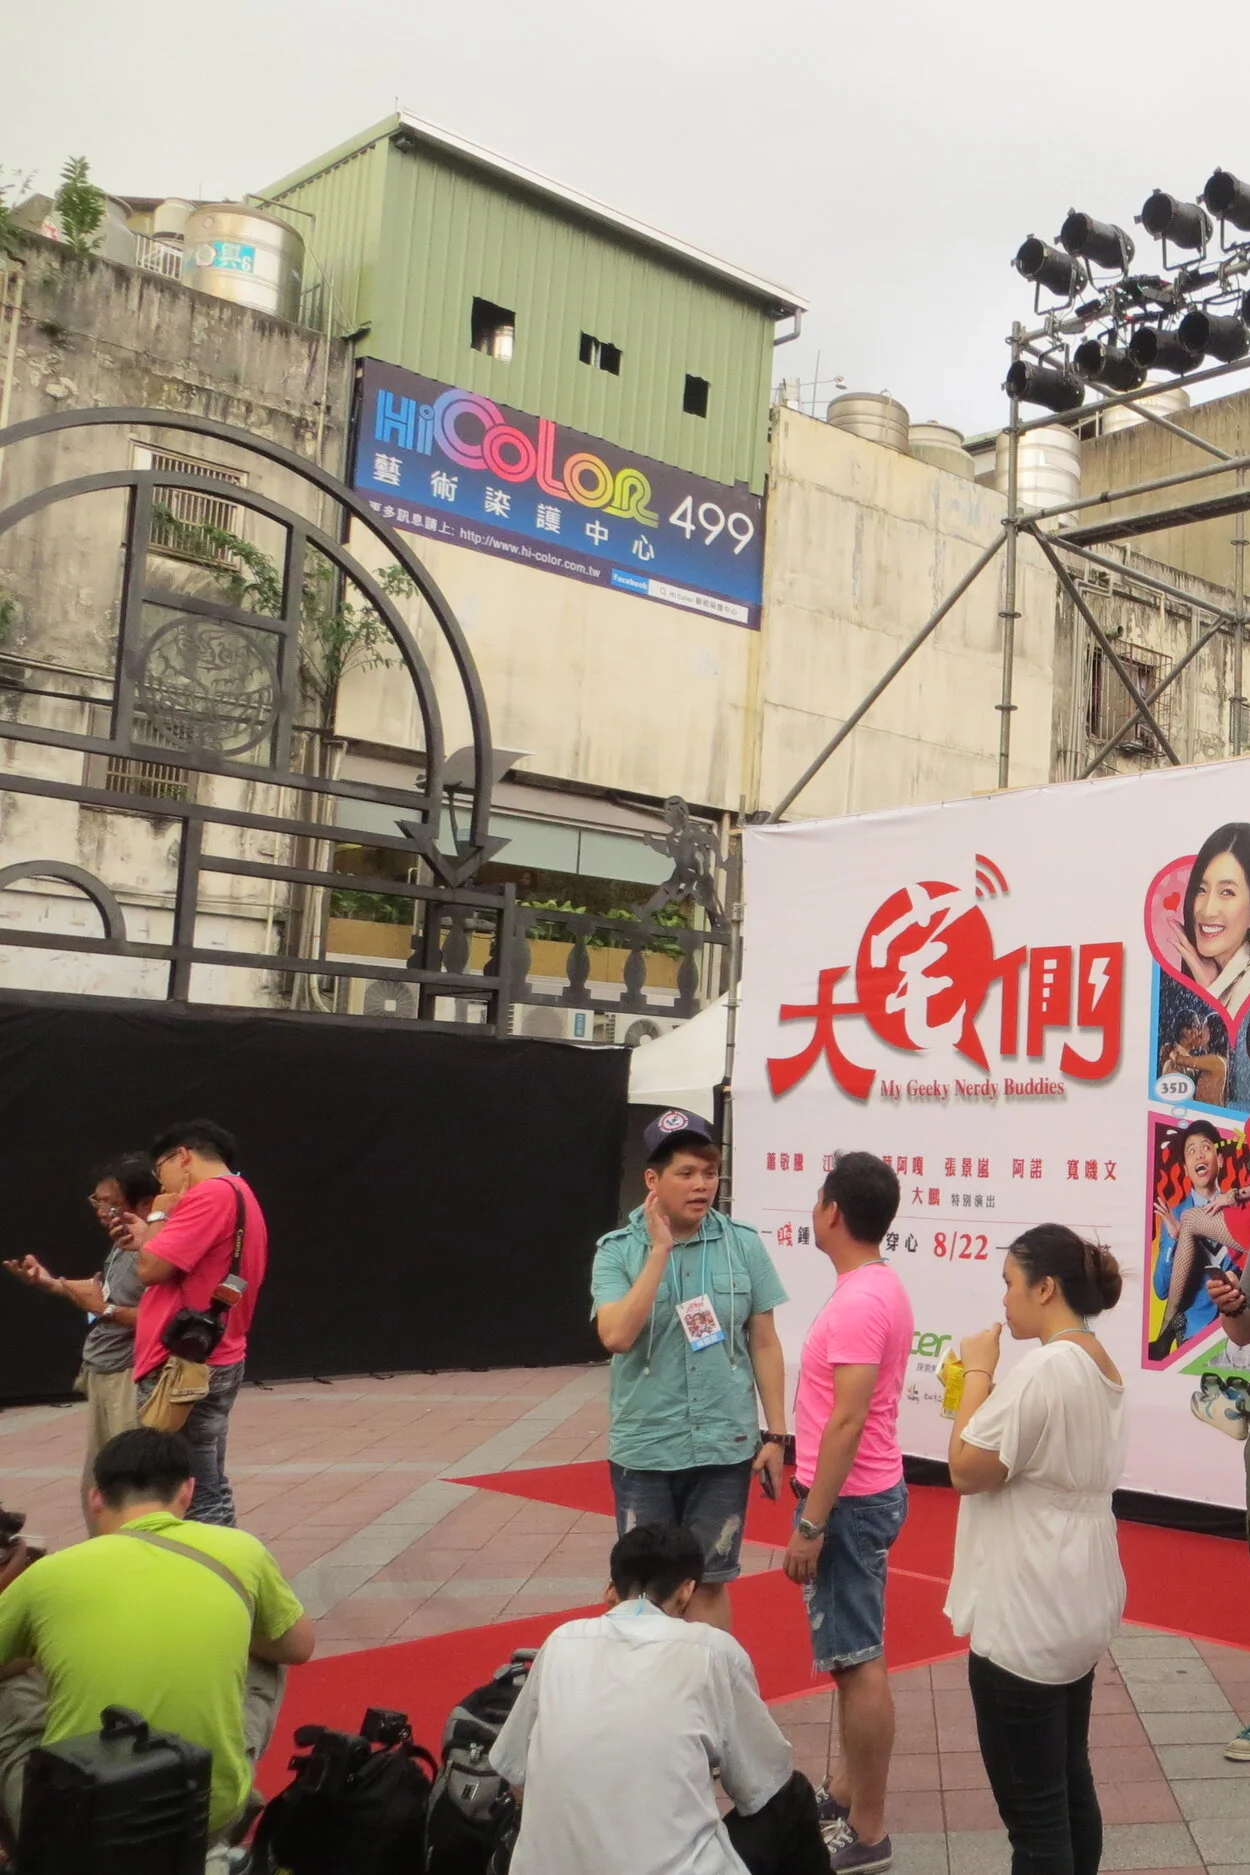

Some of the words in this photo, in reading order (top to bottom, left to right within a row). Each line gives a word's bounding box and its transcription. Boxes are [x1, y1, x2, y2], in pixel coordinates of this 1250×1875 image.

[372, 452, 656, 562] 藝術染護中心
[669, 495, 756, 556] 499
[459, 527, 601, 579] http://www.hi-color.com.tw
[881, 1079, 901, 1100] My
[906, 1079, 950, 1100] Geeky
[955, 1078, 998, 1100] Nerdy
[1004, 1077, 1065, 1096] Buddies
[1161, 1082, 1188, 1094] 35D
[1012, 1158, 1043, 1179] 阿諾
[933, 1231, 989, 1261] 8/22
